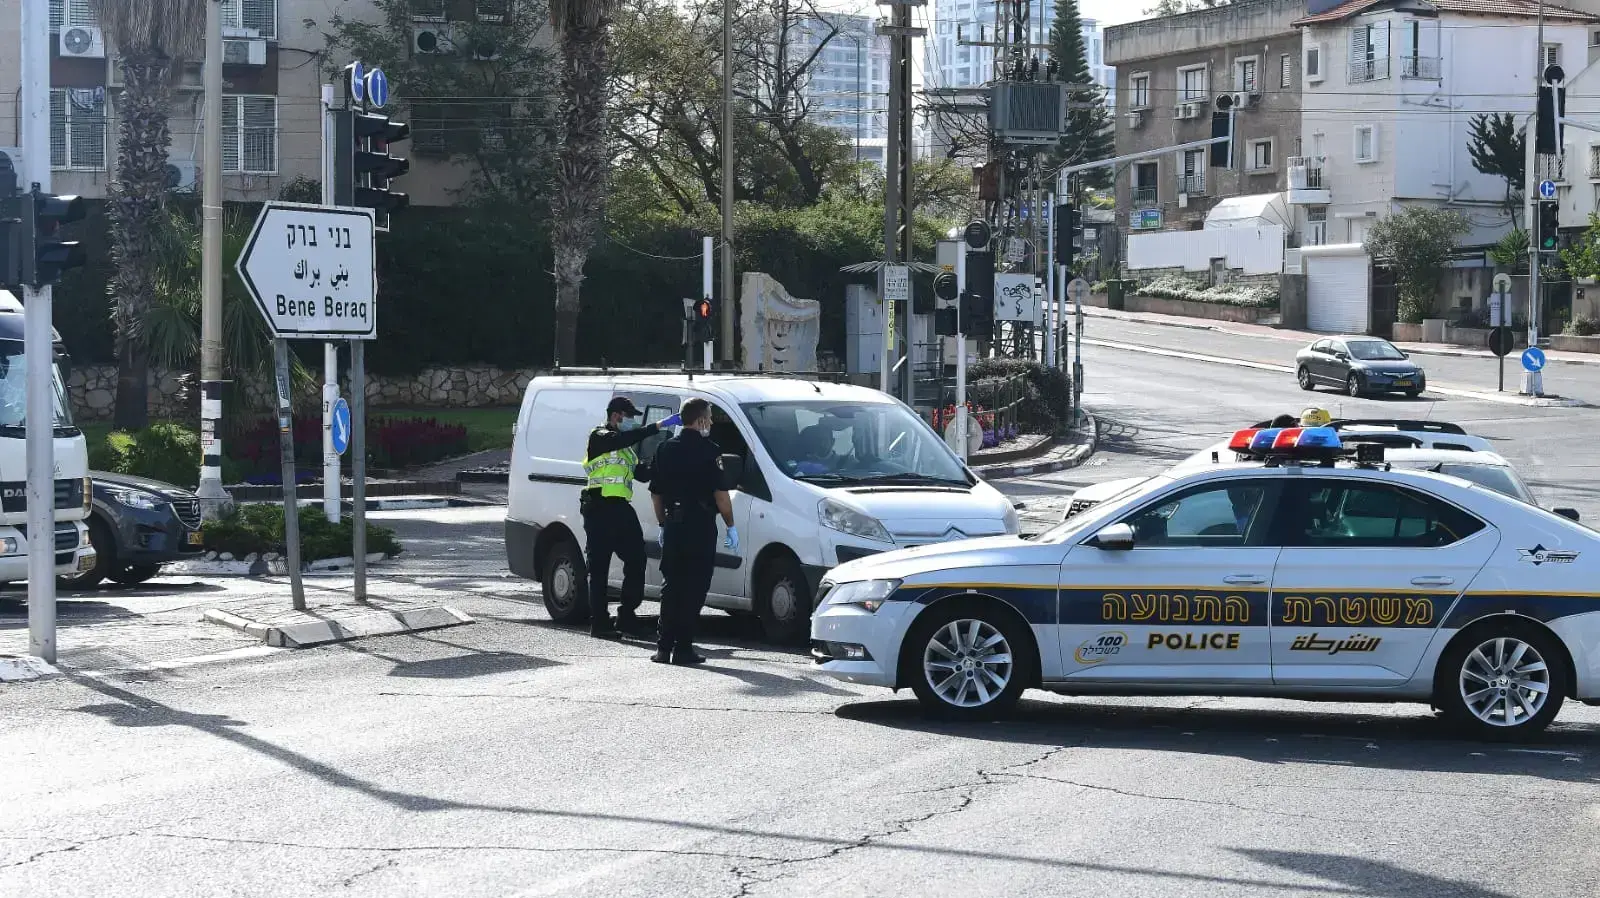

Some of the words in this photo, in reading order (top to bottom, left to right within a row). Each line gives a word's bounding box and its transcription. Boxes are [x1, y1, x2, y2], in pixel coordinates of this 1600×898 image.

[287, 224, 318, 249] ברק
[328, 227, 351, 249] בני
[294, 259, 320, 289] براك
[331, 263, 349, 291] بني
[276, 294, 316, 317] Bene
[324, 295, 367, 324] Beraq
[1102, 593, 1249, 622] התנועה
[1282, 596, 1434, 625] משטרת
[1082, 646, 1120, 657] בשבילך
[1096, 635, 1123, 647] 100
[1147, 632, 1241, 650] POLICE
[1290, 632, 1382, 656] الشرطة
